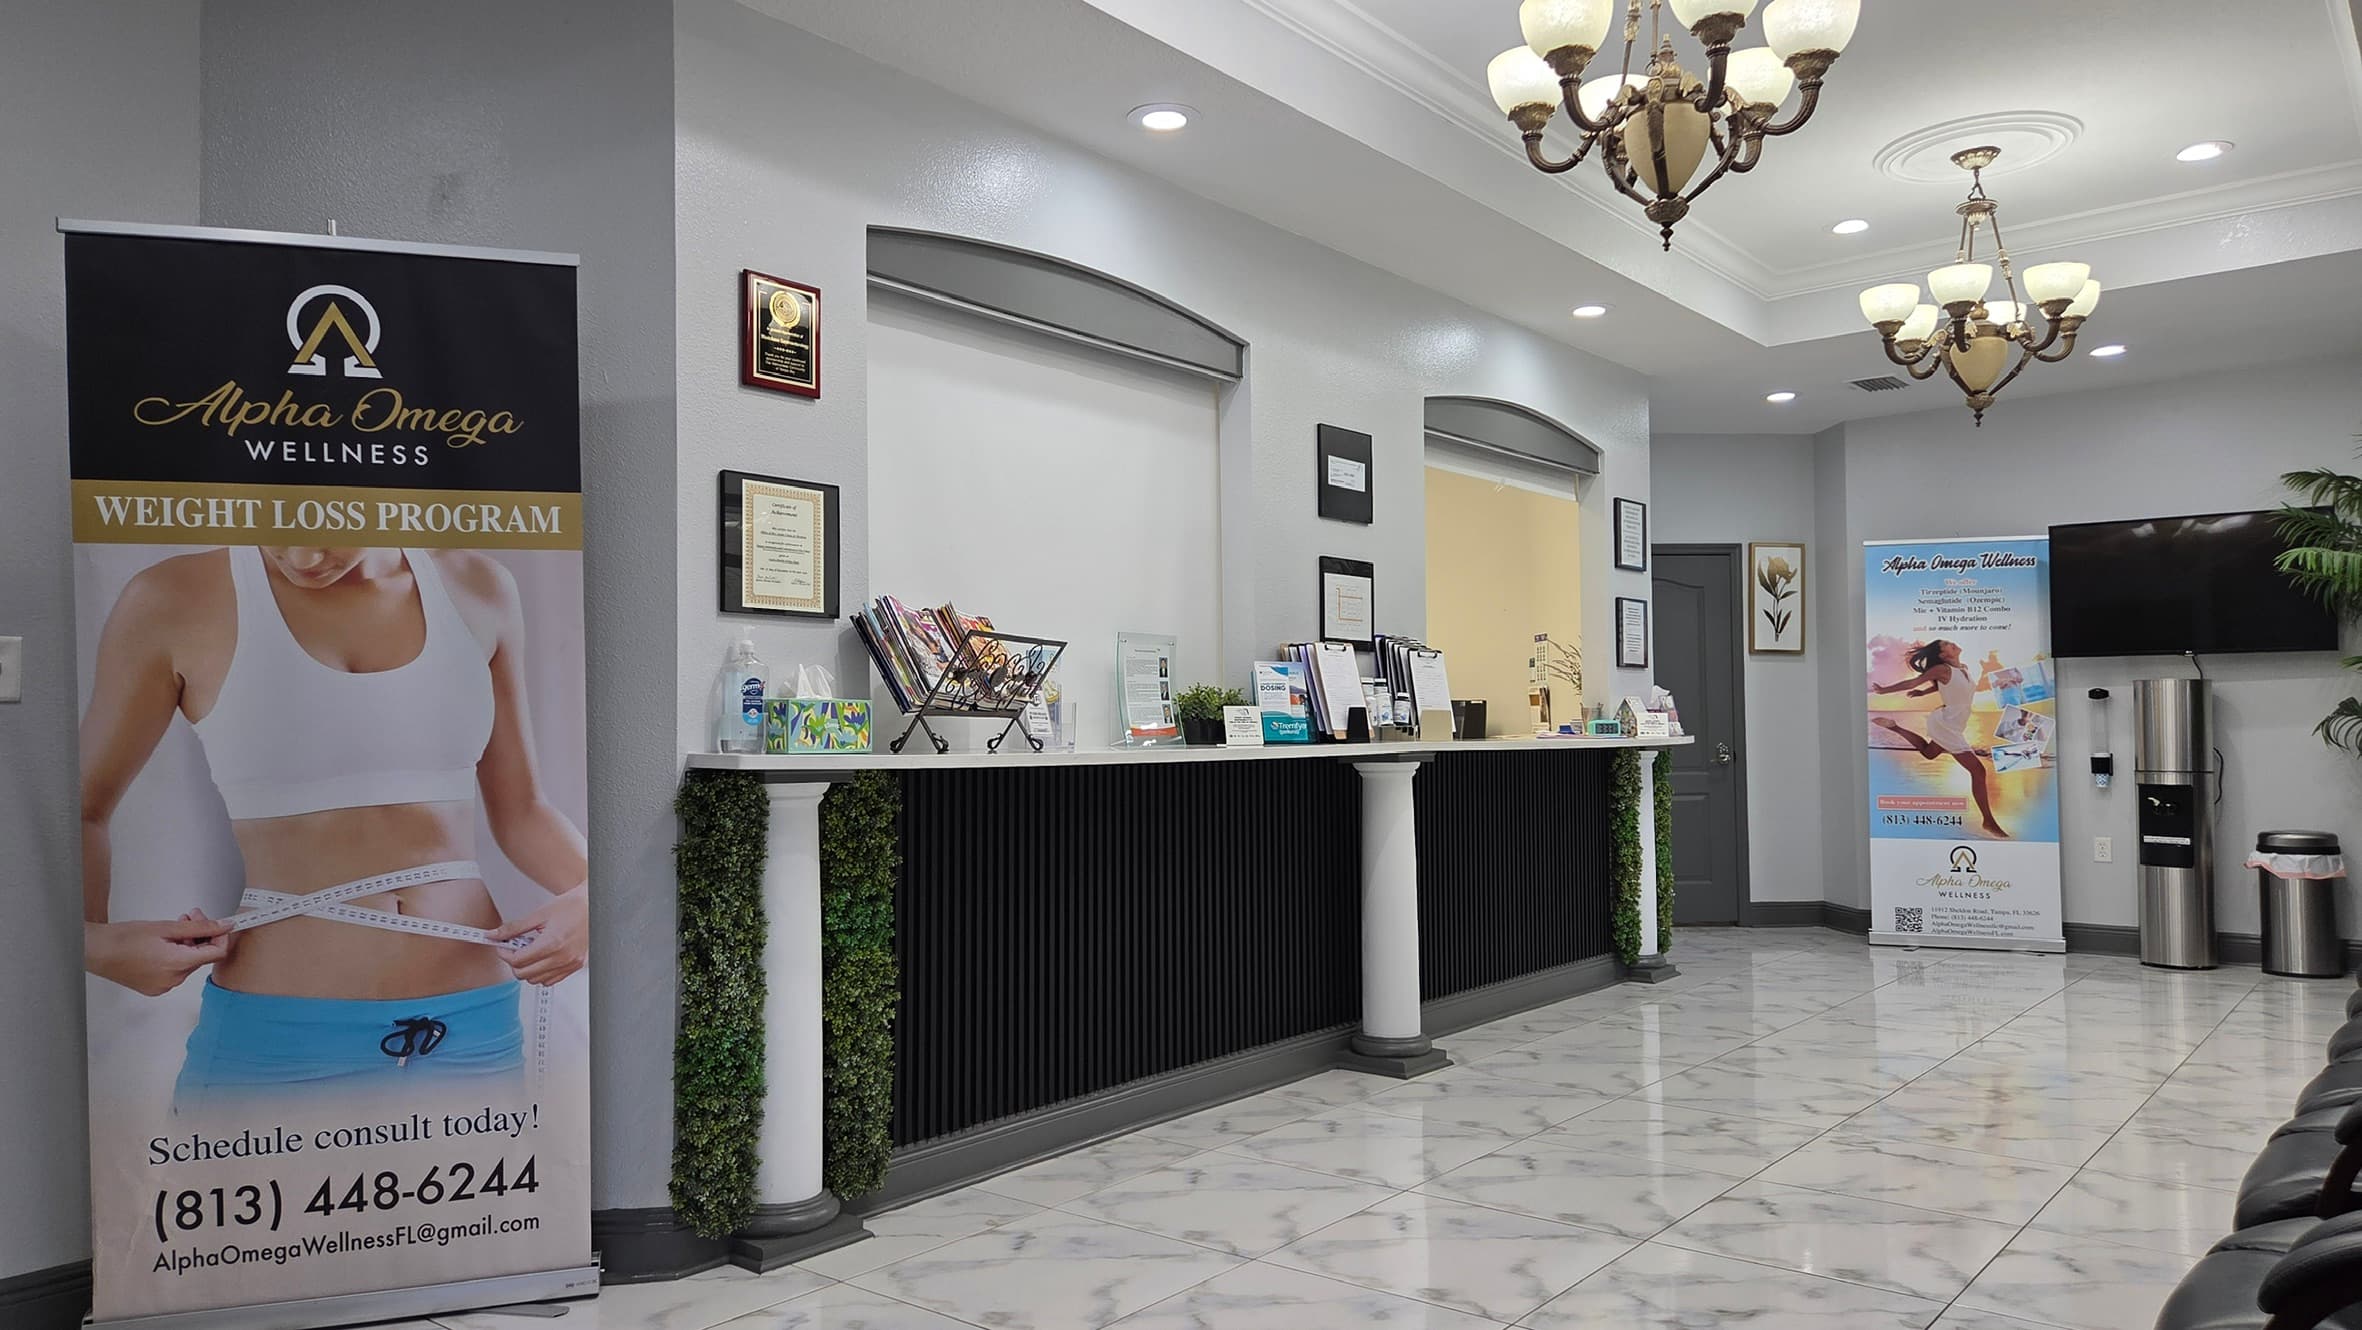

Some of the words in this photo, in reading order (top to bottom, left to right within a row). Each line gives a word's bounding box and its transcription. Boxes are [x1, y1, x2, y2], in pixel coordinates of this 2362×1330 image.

[134, 380, 343, 437] Alpha
[352, 388, 524, 448] Omega
[245, 440, 429, 466] WELLNESS
[94, 495, 261, 529] WEIGHT
[272, 500, 366, 531] LOSS
[376, 503, 561, 534] PROGRAM
[1882, 556, 1926, 575] Alpha
[1931, 554, 1977, 574] Omega
[1980, 553, 2036, 569] Wellness
[1949, 615, 1988, 623] Hydration
[1882, 814, 1910, 825] (813)
[1912, 815, 1962, 826] 448-6244
[1916, 873, 1963, 888] Alpha
[1968, 874, 2011, 891] Omega
[1939, 891, 1991, 900] WELLNESS
[149, 1127, 303, 1165] Schedule
[314, 1113, 432, 1150] consult
[443, 1103, 540, 1140] today!
[154, 1179, 283, 1242] (813)
[303, 1154, 540, 1217] 448-6244
[153, 1213, 540, 1276] AlphaOmegaWellnessFL@gmail.com
